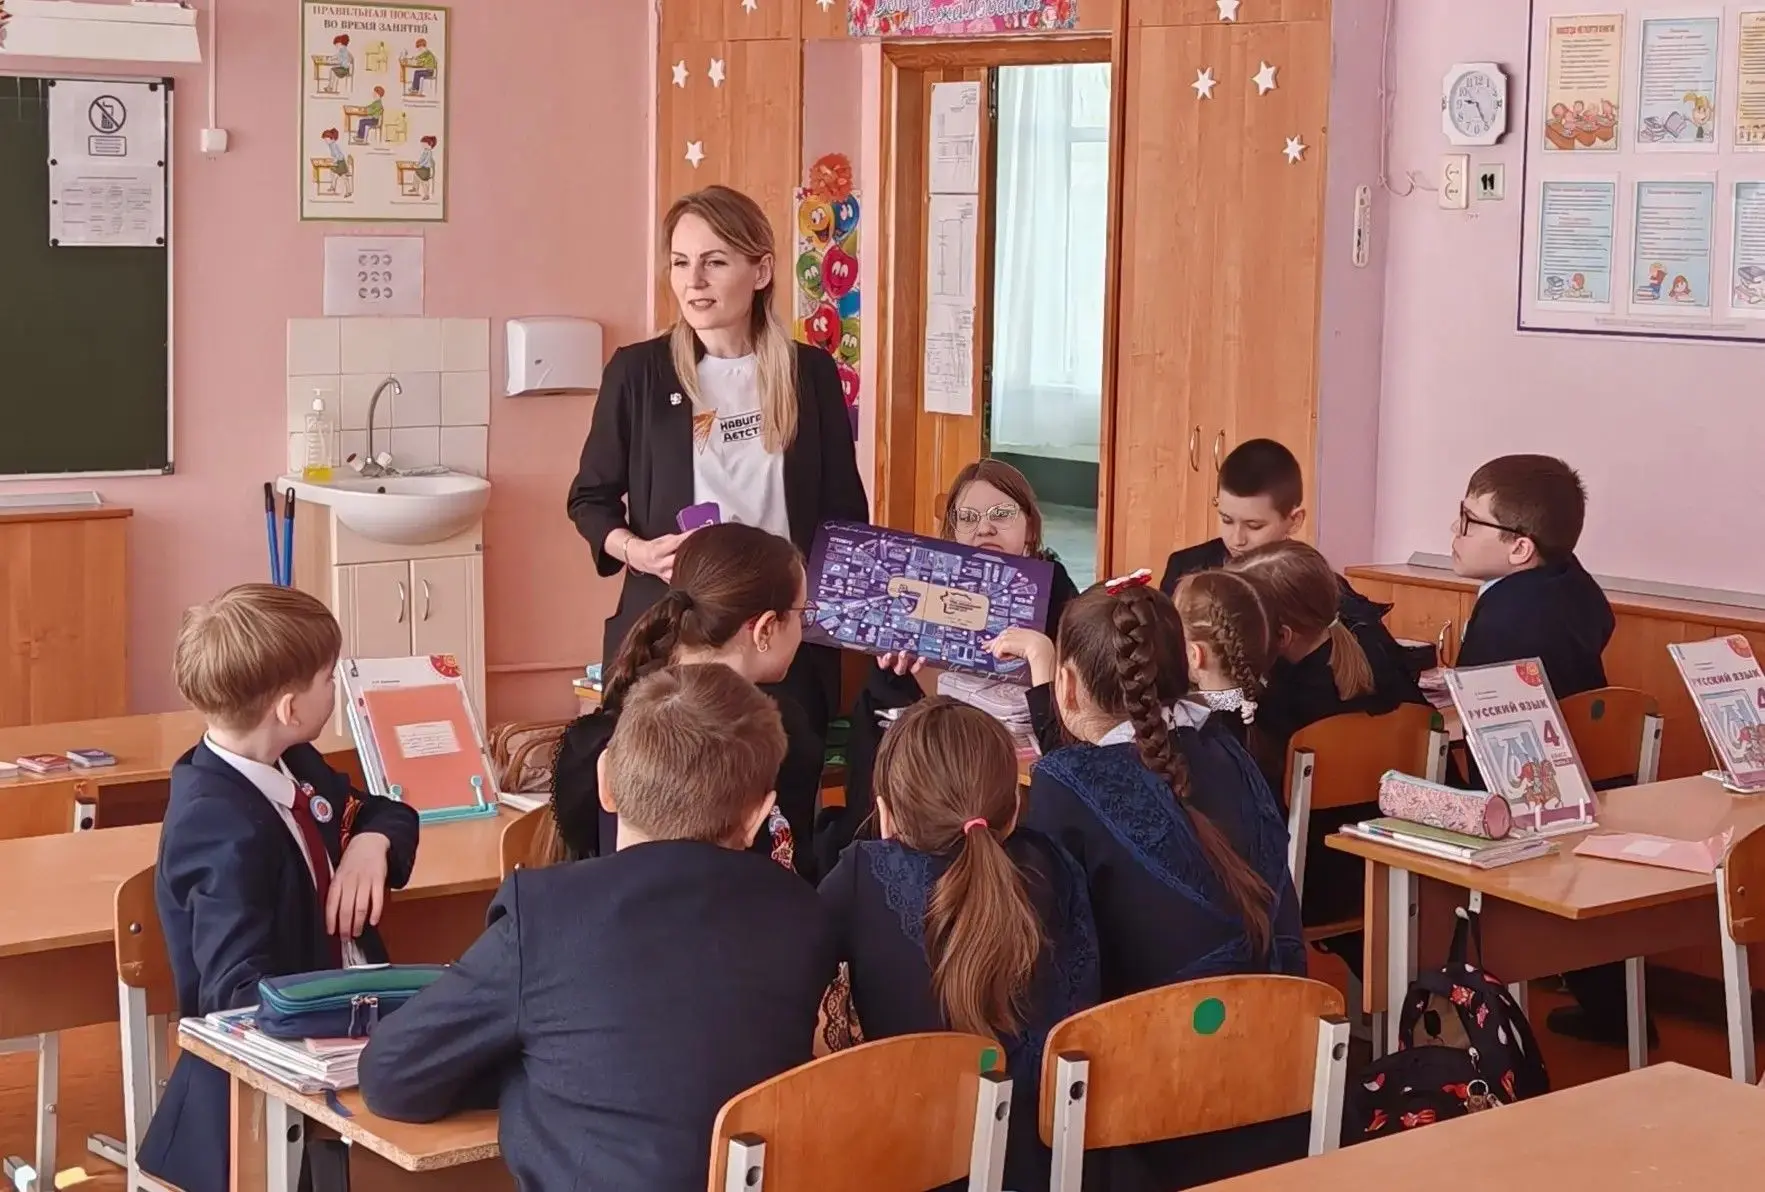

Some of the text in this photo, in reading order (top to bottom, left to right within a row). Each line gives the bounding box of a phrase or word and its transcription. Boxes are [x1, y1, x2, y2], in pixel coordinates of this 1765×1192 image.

[312, 5, 439, 21] ПРАВИЛЬНАЯ ПОСАДКА
[323, 19, 429, 34] ВО ВРЕМЯ ЗАНЯТИЙ
[723, 426, 761, 442] ДЕТСТ
[1519, 699, 1549, 713] ЯЗЫК
[1543, 719, 1560, 747] 4
